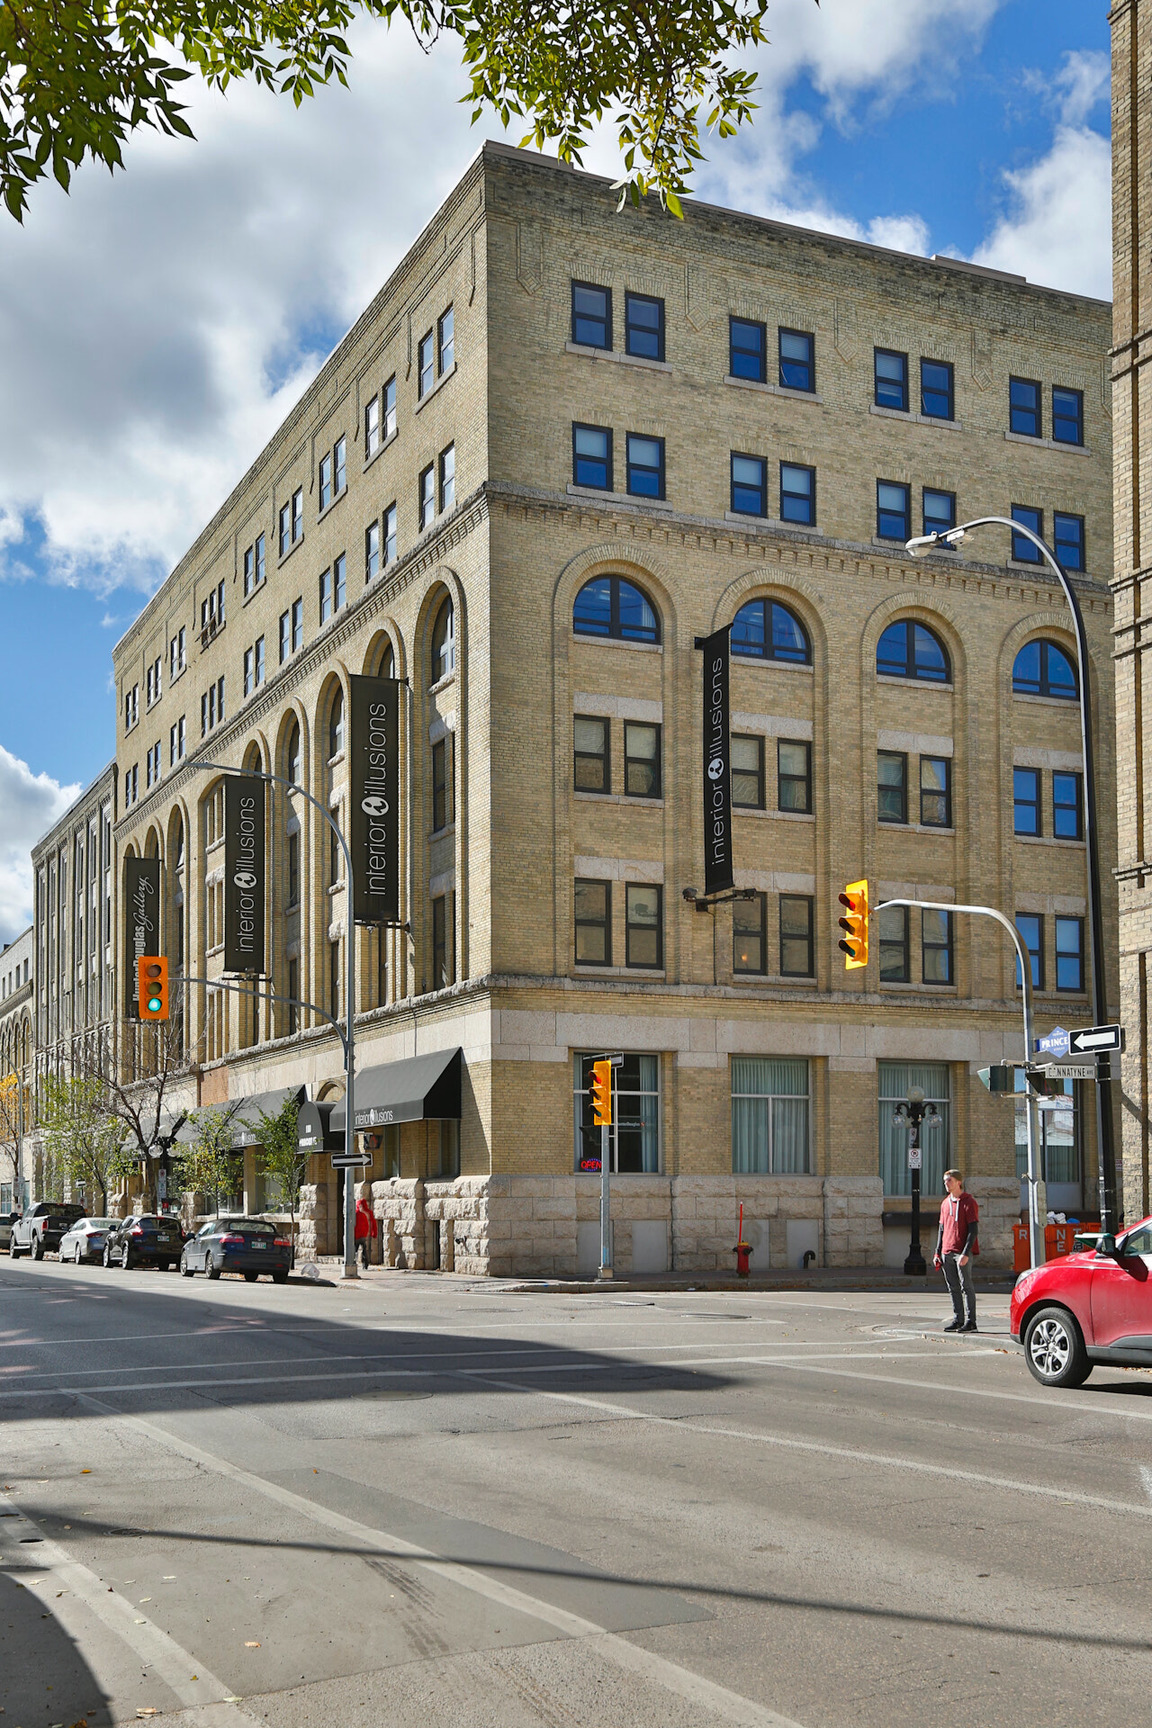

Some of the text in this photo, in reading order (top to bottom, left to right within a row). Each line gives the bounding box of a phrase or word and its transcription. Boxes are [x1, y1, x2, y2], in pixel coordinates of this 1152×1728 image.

[709, 657, 723, 758] illusions
[364, 703, 387, 795] illusions
[235, 797, 255, 872] illusions
[364, 819, 387, 895] interior
[710, 783, 724, 865] interior
[133, 876, 154, 931] Gallery
[235, 890, 255, 953] interior
[580, 1160, 602, 1170] OPEN
